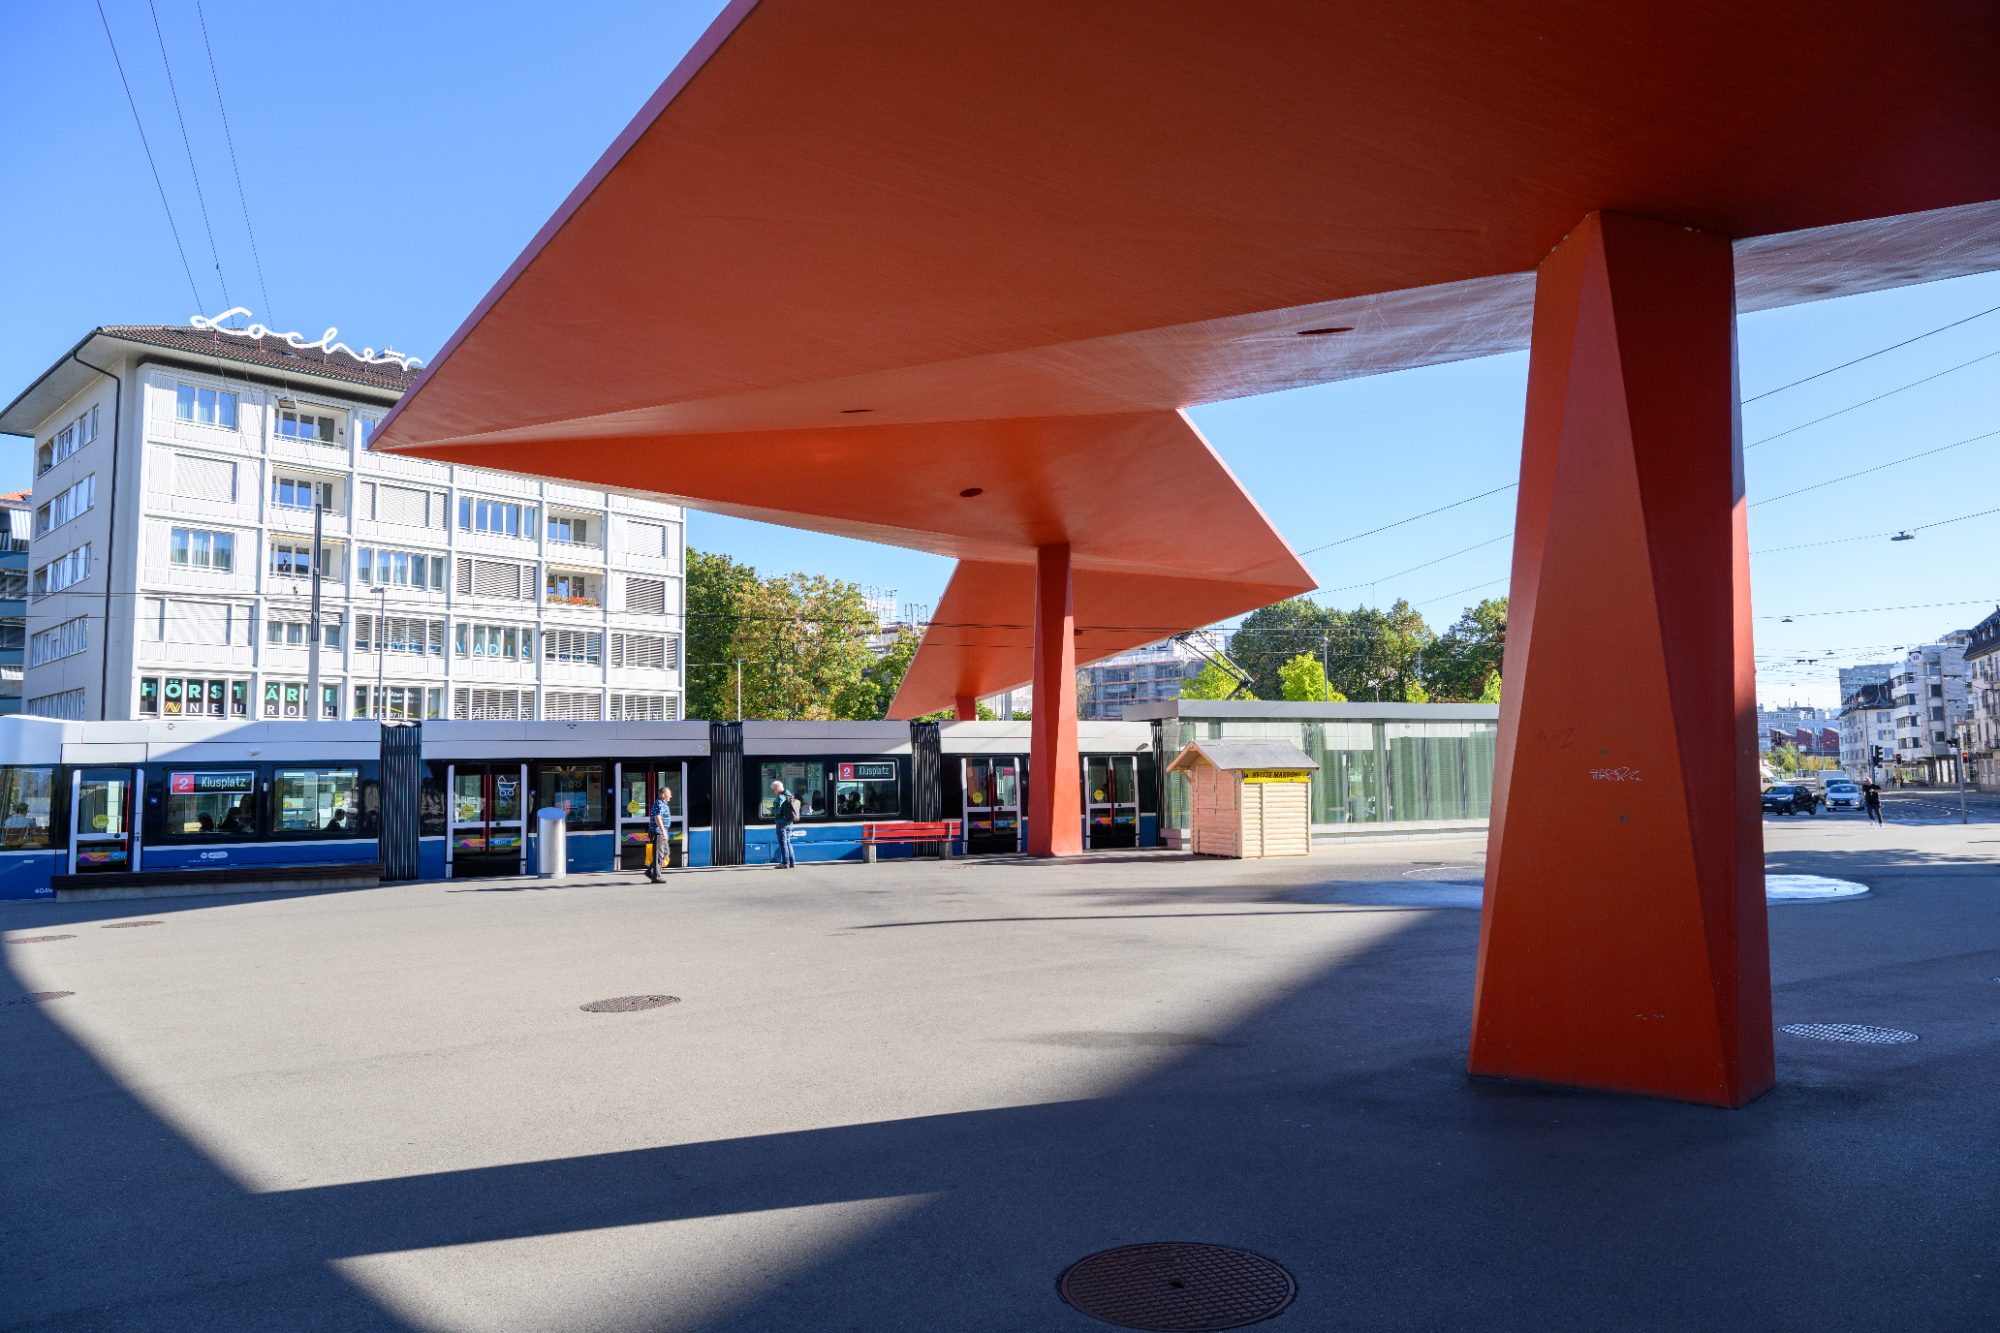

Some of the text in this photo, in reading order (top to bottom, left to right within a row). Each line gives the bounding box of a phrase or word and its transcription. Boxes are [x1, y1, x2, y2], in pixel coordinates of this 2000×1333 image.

[141, 680, 335, 703] HÖRSTÄRE
[189, 702, 335, 717] NEUROH
[843, 765, 889, 776] 2 Klusplatz
[179, 776, 246, 789] 2 Klusplatz
